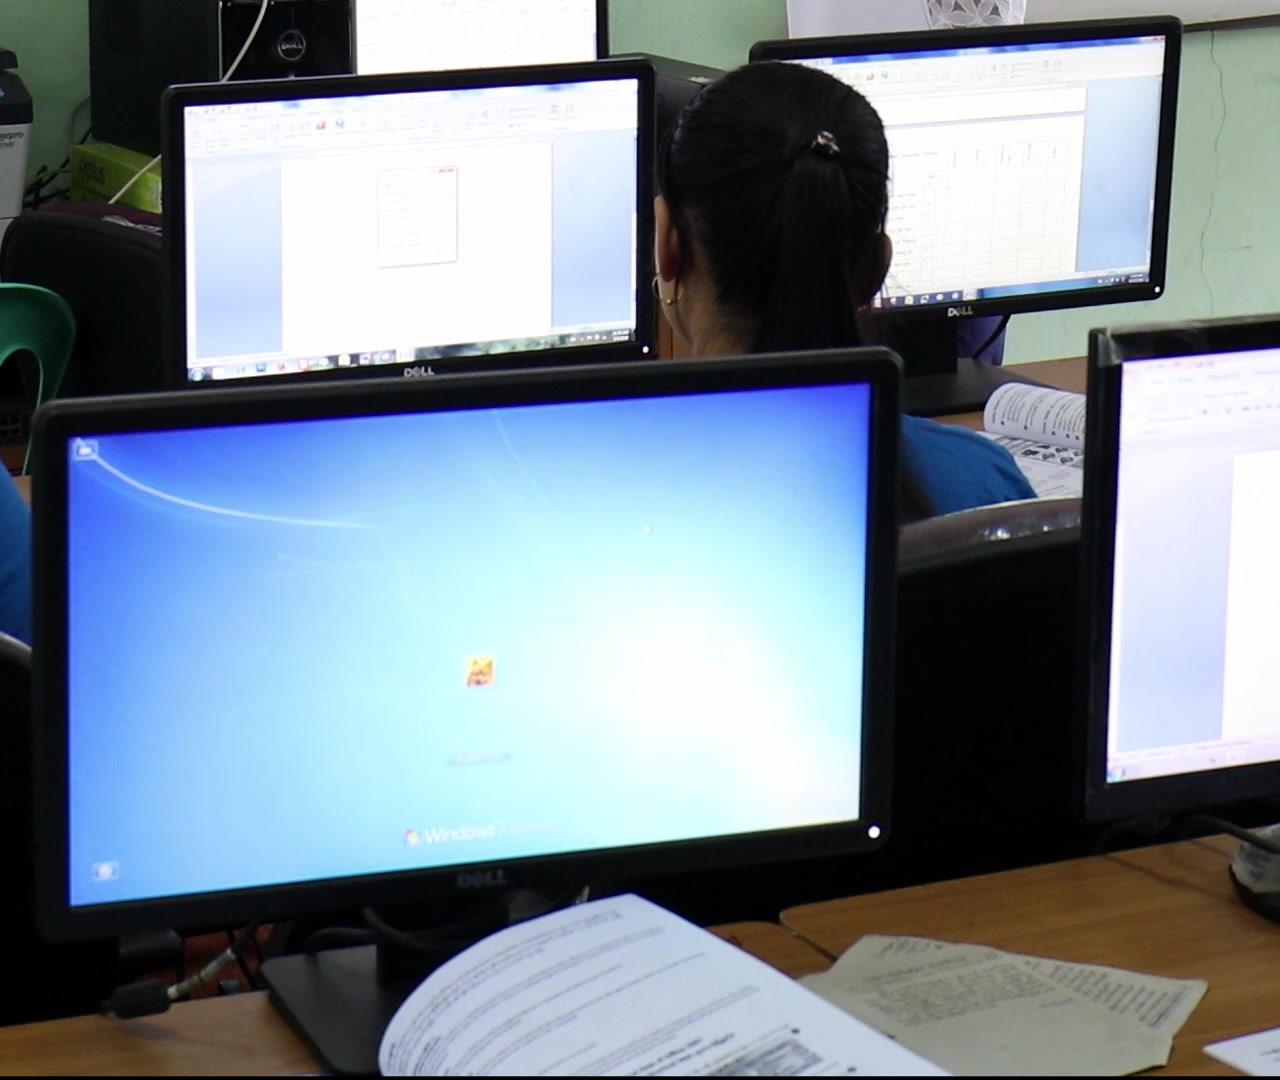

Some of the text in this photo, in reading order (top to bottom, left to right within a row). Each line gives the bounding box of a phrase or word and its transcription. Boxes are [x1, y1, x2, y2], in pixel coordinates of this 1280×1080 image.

[947, 305, 974, 317] DELL
[403, 366, 435, 378] DELL
[424, 824, 496, 844] Windows
[456, 870, 508, 888] DELL
